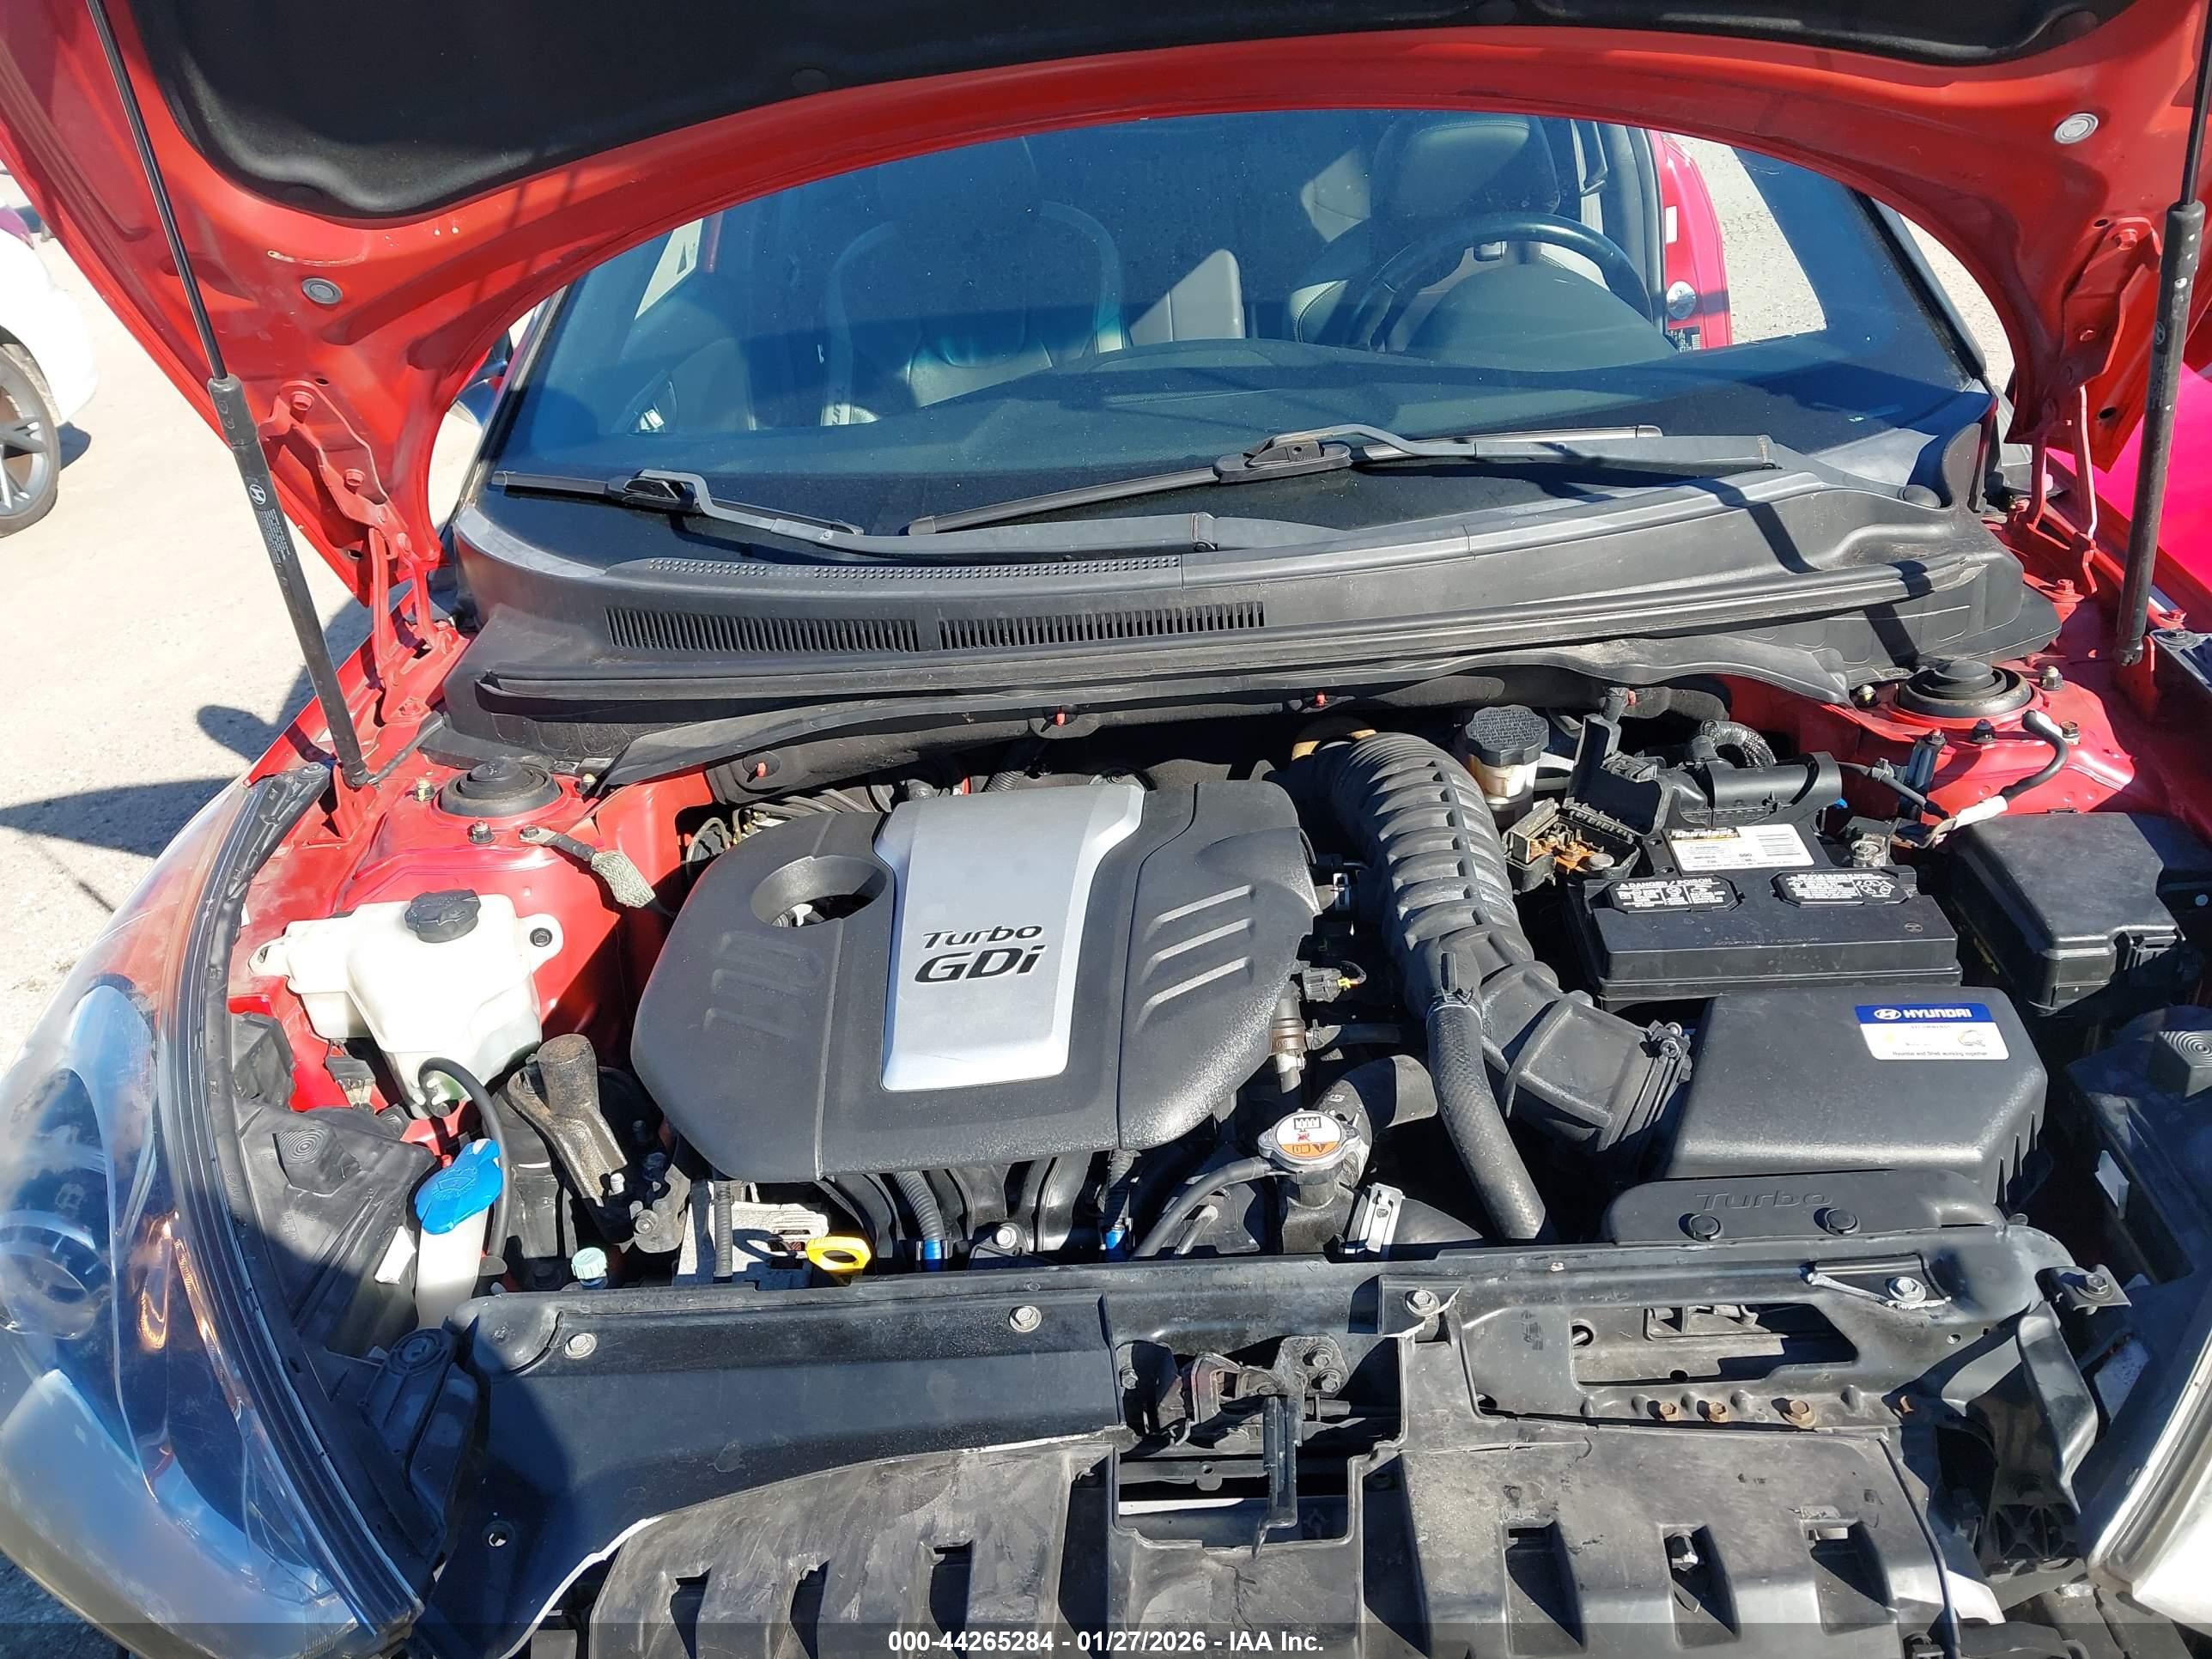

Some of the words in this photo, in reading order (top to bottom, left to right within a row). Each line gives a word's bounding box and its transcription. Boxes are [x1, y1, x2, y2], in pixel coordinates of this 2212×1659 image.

[923, 926, 1042, 949] Turbo
[914, 945, 1047, 983] GDi
[1903, 1008, 1972, 1018] HYUNDAI
[1695, 1190, 1834, 1211] Turbo
